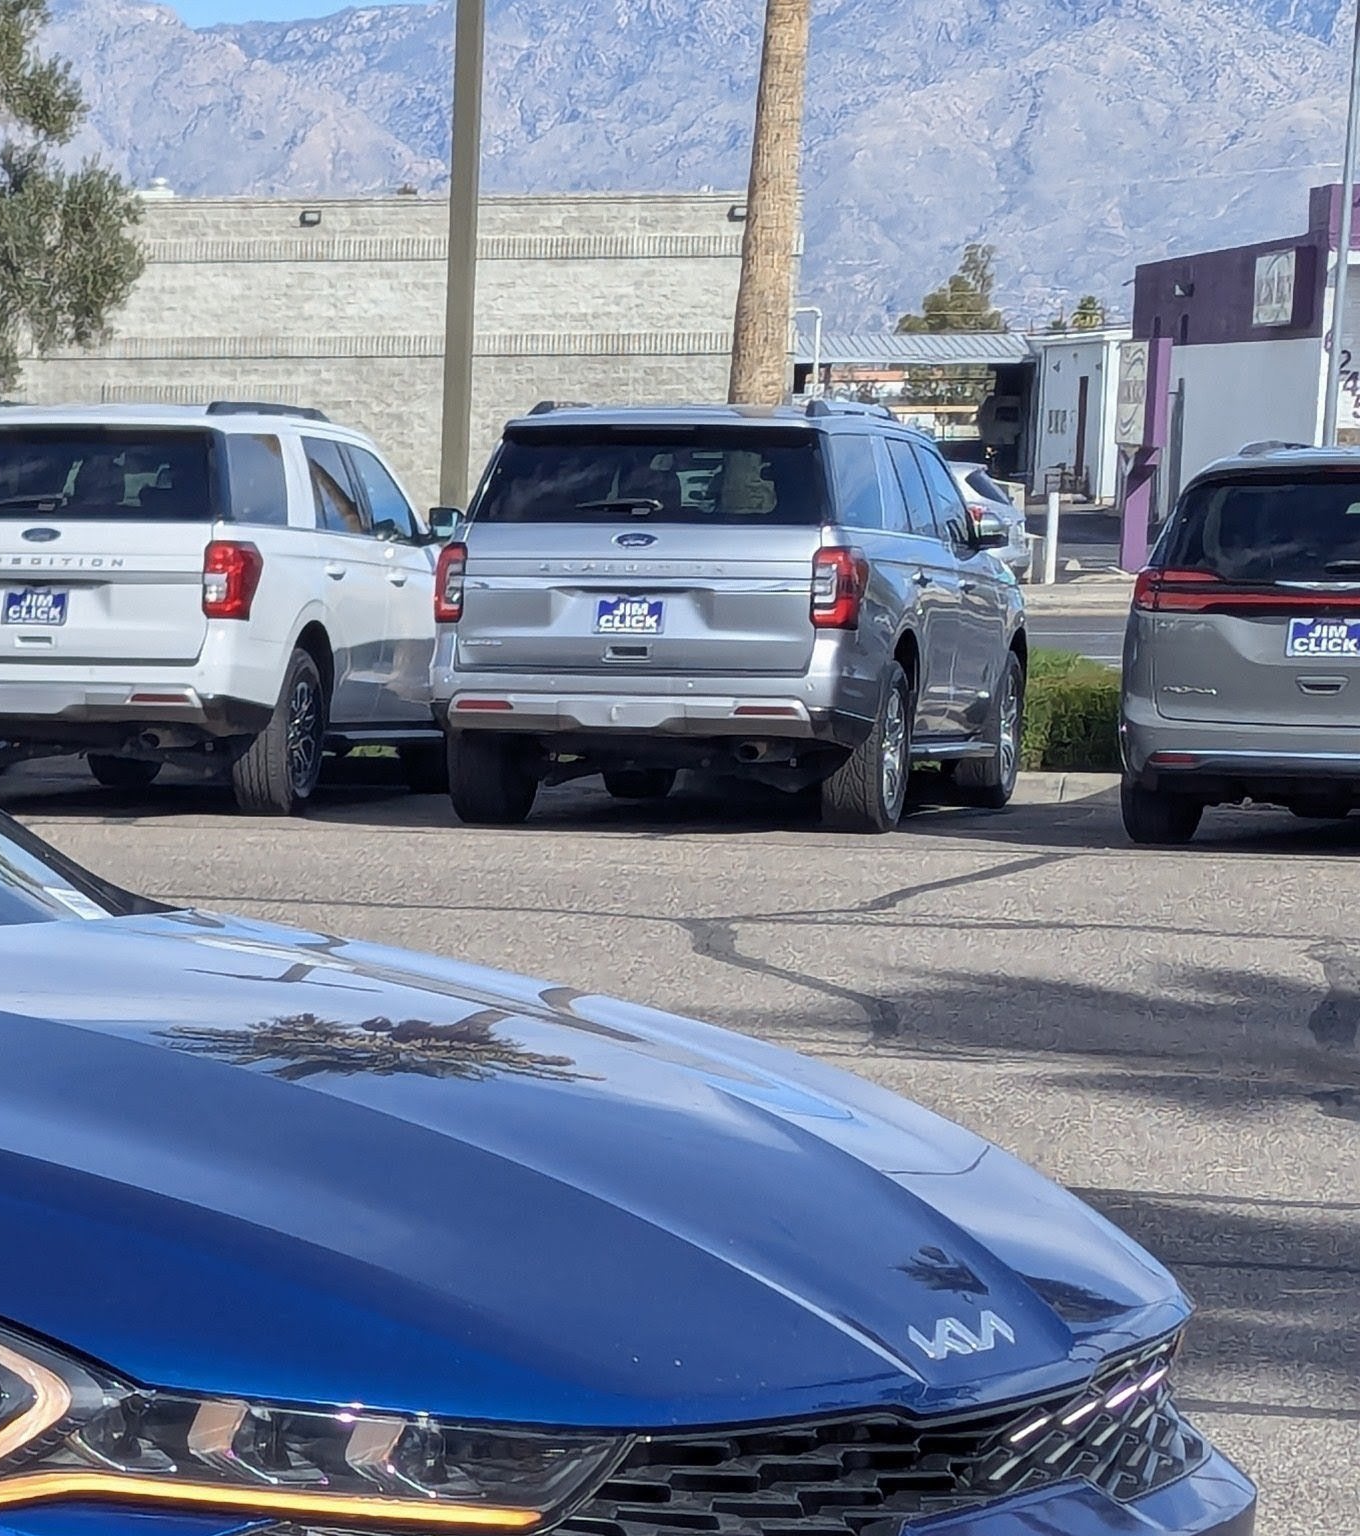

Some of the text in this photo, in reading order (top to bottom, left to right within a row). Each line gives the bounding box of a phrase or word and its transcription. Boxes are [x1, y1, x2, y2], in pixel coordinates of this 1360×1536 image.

[20, 594, 53, 607] JIM
[8, 605, 61, 619] CLICK
[612, 602, 649, 616] JIM
[599, 614, 659, 628] CLICK
[1308, 624, 1348, 638] JIM
[1293, 637, 1358, 652] CLICK
